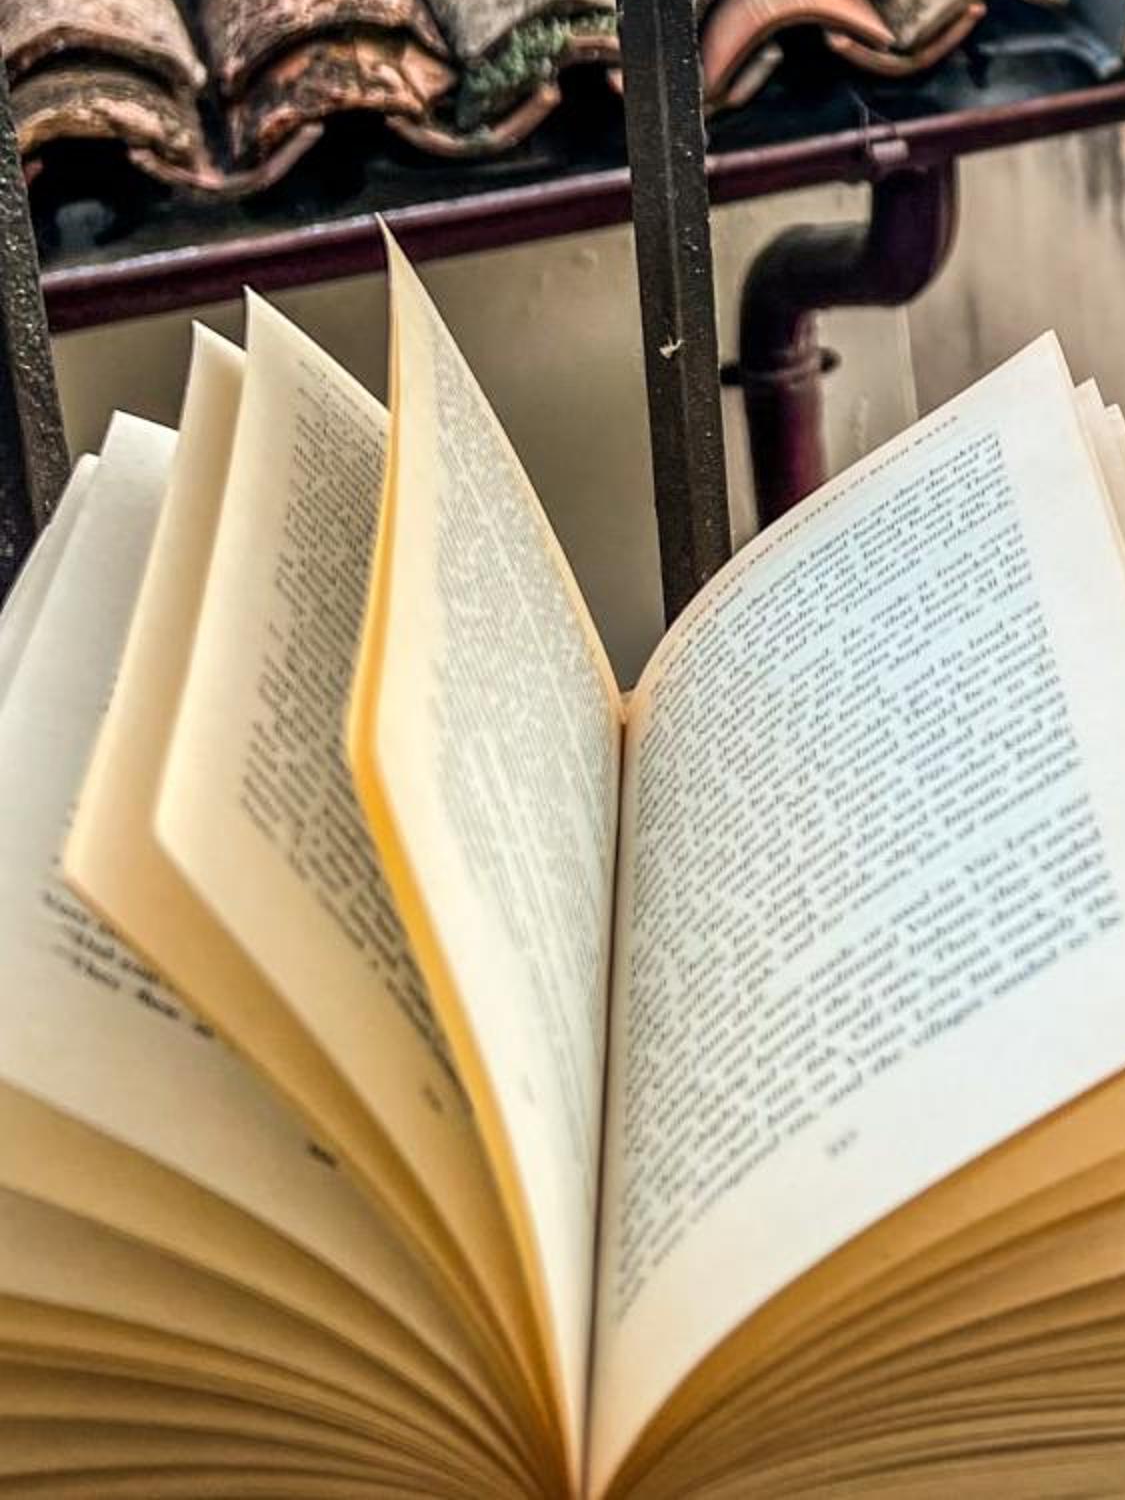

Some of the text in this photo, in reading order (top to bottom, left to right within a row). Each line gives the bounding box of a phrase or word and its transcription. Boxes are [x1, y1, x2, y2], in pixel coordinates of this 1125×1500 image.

[840, 624, 863, 644] He
[869, 592, 909, 624] made
[924, 581, 968, 615] bread
[902, 664, 935, 692] said
[939, 649, 963, 668] his
[967, 619, 1004, 649] land
[1009, 599, 1040, 622] was
[956, 630, 1019, 672] Canada
[995, 625, 1048, 664] would
[853, 739, 899, 778] bread
[905, 700, 957, 740] would
[963, 687, 983, 703] be
[893, 726, 947, 766] would
[954, 695, 998, 726] learn
[1005, 678, 1024, 694] to
[1032, 658, 1056, 676] do
[894, 787, 912, 803] in
[956, 746, 975, 762] as
[980, 715, 1024, 747] there
[1029, 690, 1065, 714] was
[914, 725, 974, 771] instead
[1006, 674, 1061, 711] cream
[890, 797, 925, 822] was
[930, 751, 996, 797] another
[1003, 718, 1043, 751] kind
[1049, 703, 1068, 722] of
[955, 820, 975, 840] of
[981, 757, 1082, 824] marmalade
[1014, 736, 1079, 783] corned
[817, 869, 849, 895] was
[853, 811, 928, 868] standard
[961, 761, 1009, 797] many
[1015, 723, 1072, 763] Pacific
[805, 932, 899, 1006] traditional
[1029, 844, 1039, 859] I
[1044, 811, 1095, 849] never
[808, 946, 855, 983] made
[861, 925, 882, 945] or
[889, 889, 930, 925] used
[937, 877, 956, 894] in
[1057, 791, 1091, 818] nor
[988, 873, 1031, 904] they
[1038, 826, 1102, 872] waded
[890, 989, 920, 1015] the
[927, 945, 990, 990] beaten
[1062, 869, 1111, 905] there
[932, 928, 979, 961] They
[987, 888, 1043, 928] threw
[1012, 916, 1075, 961] mostly
[1084, 890, 1118, 914] the
[827, 1071, 863, 1107] and
[871, 1049, 902, 1075] the
[910, 998, 983, 1048] villages
